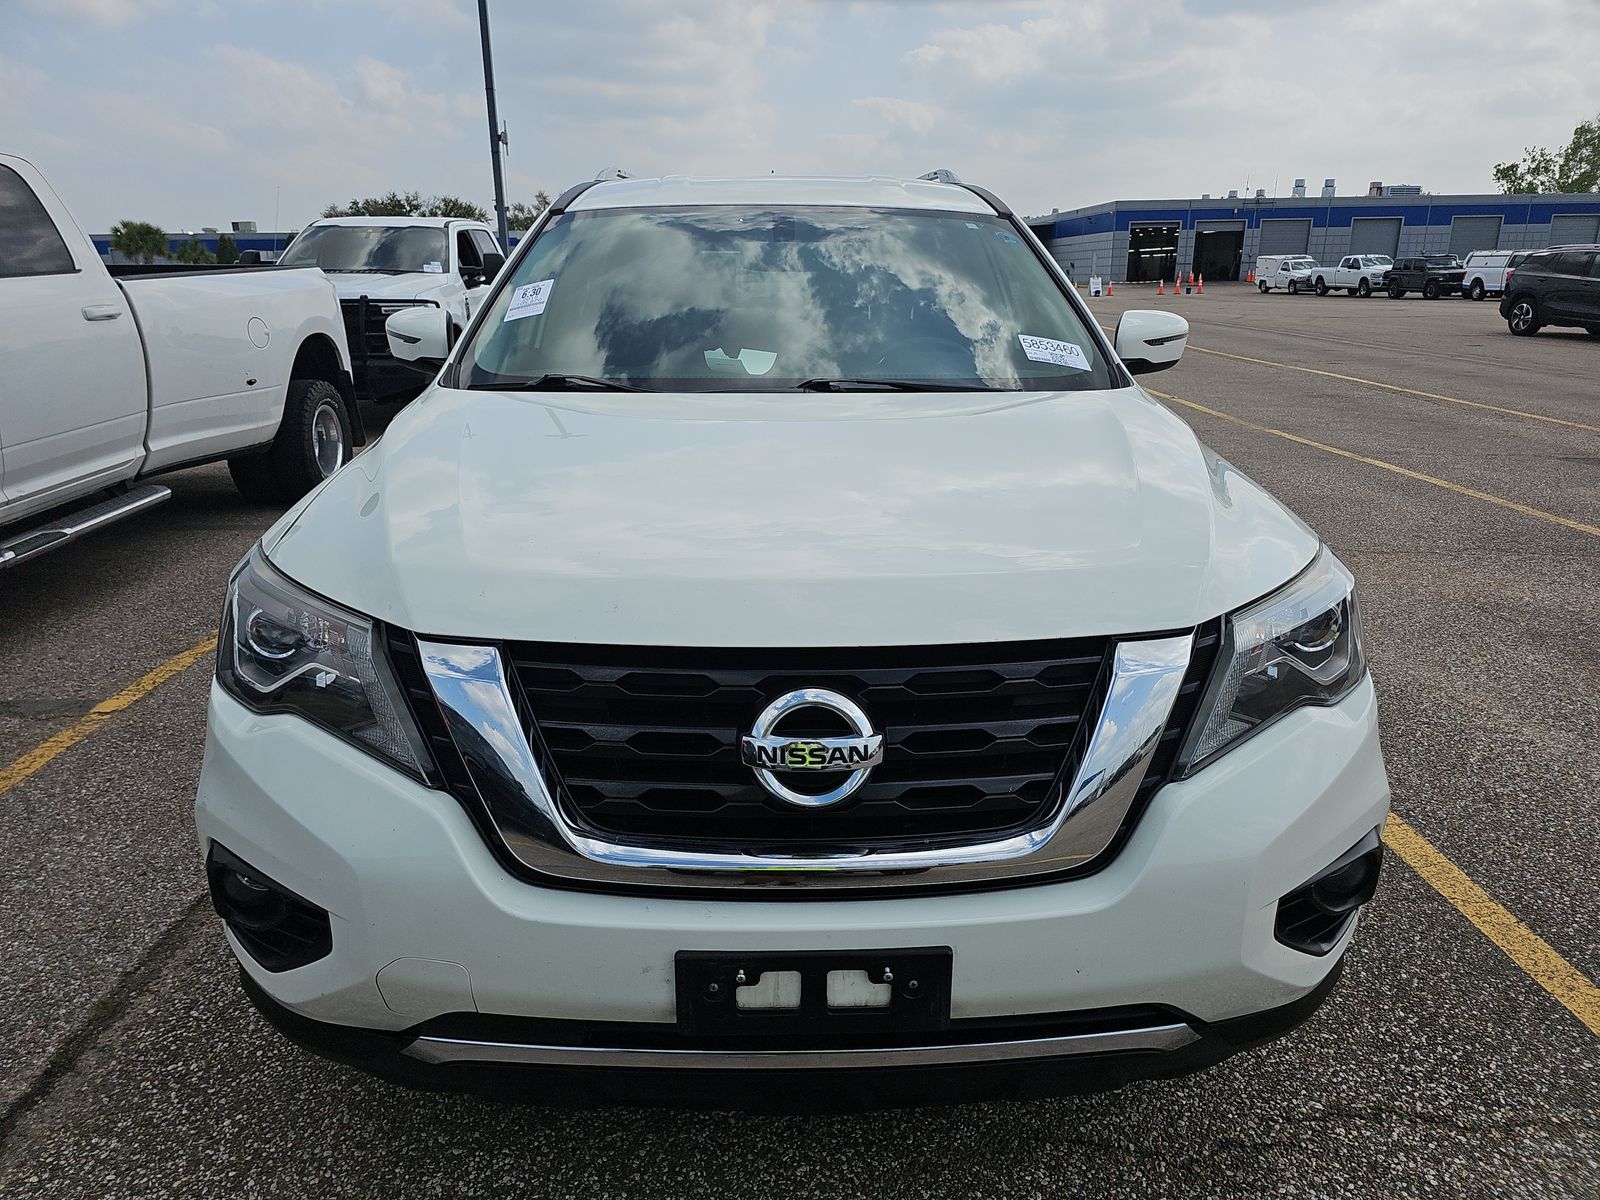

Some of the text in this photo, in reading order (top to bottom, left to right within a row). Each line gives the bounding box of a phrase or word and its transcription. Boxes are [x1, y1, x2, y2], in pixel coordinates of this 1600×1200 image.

[521, 287, 542, 299] 6:30
[1023, 338, 1080, 357] 5853460
[757, 744, 869, 765] NISSAN
